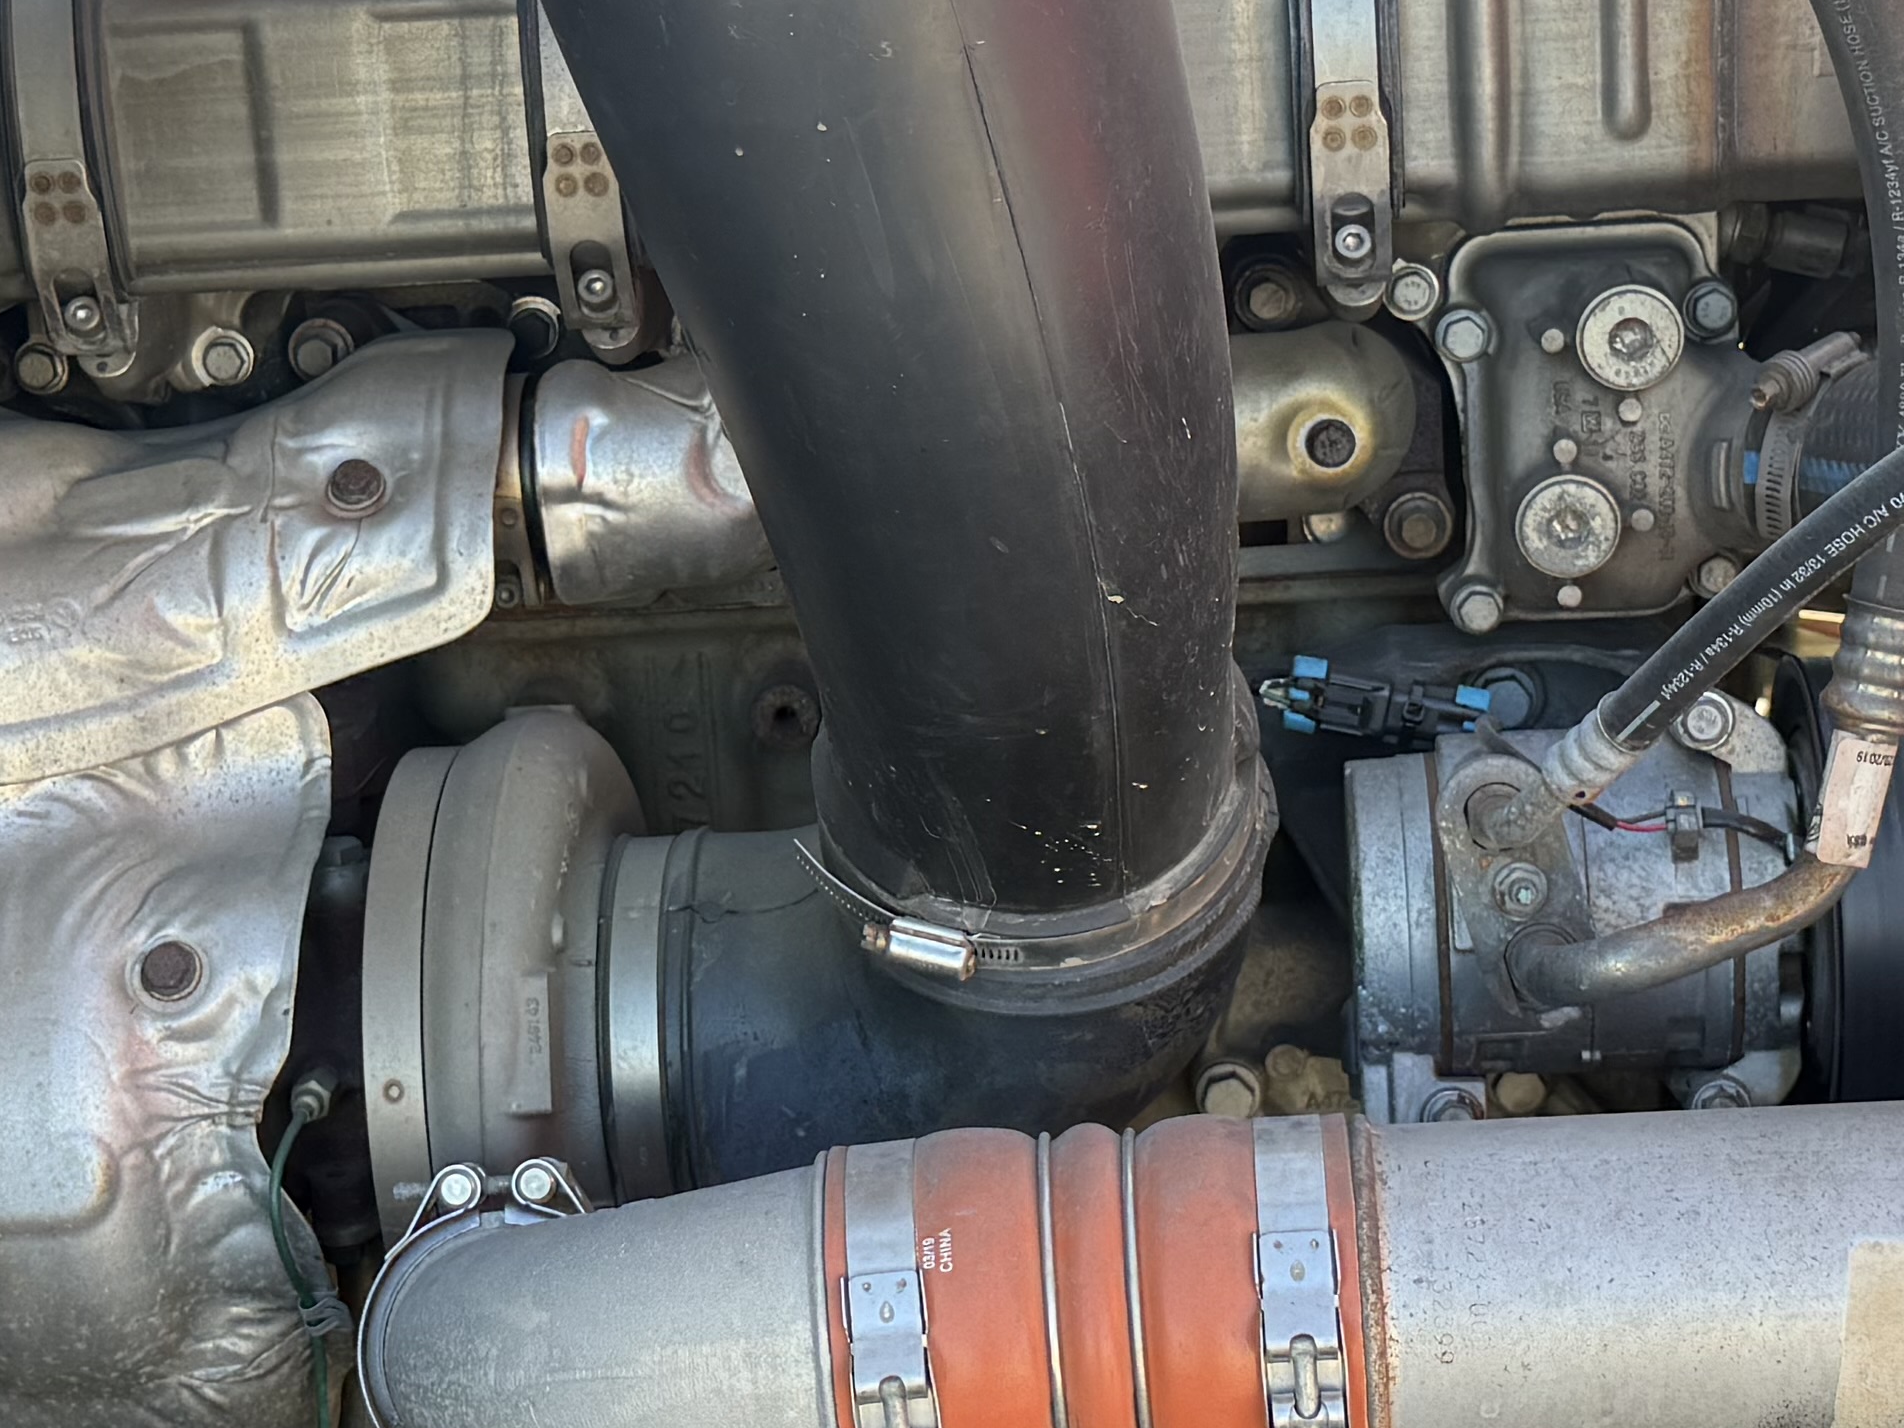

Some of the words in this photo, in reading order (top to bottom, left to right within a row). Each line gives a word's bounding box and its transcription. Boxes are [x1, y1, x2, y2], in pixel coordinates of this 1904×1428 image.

[1837, 11, 1864, 58] HOSE
[1857, 59, 1885, 127] SUCTION
[1873, 130, 1893, 156] A/C
[1879, 161, 1903, 222] R-1234yf
[1863, 503, 1890, 530] A/C
[1824, 524, 1866, 560] HOSE
[1792, 551, 1827, 584] 13/32
[1779, 580, 1797, 592] in
[1739, 588, 1781, 627] (10mm)
[1704, 623, 1743, 656] R-134a
[1660, 659, 1703, 700] R-1234yf
[922, 1237, 934, 1268] 03/19
[938, 1227, 952, 1272] CHINA
